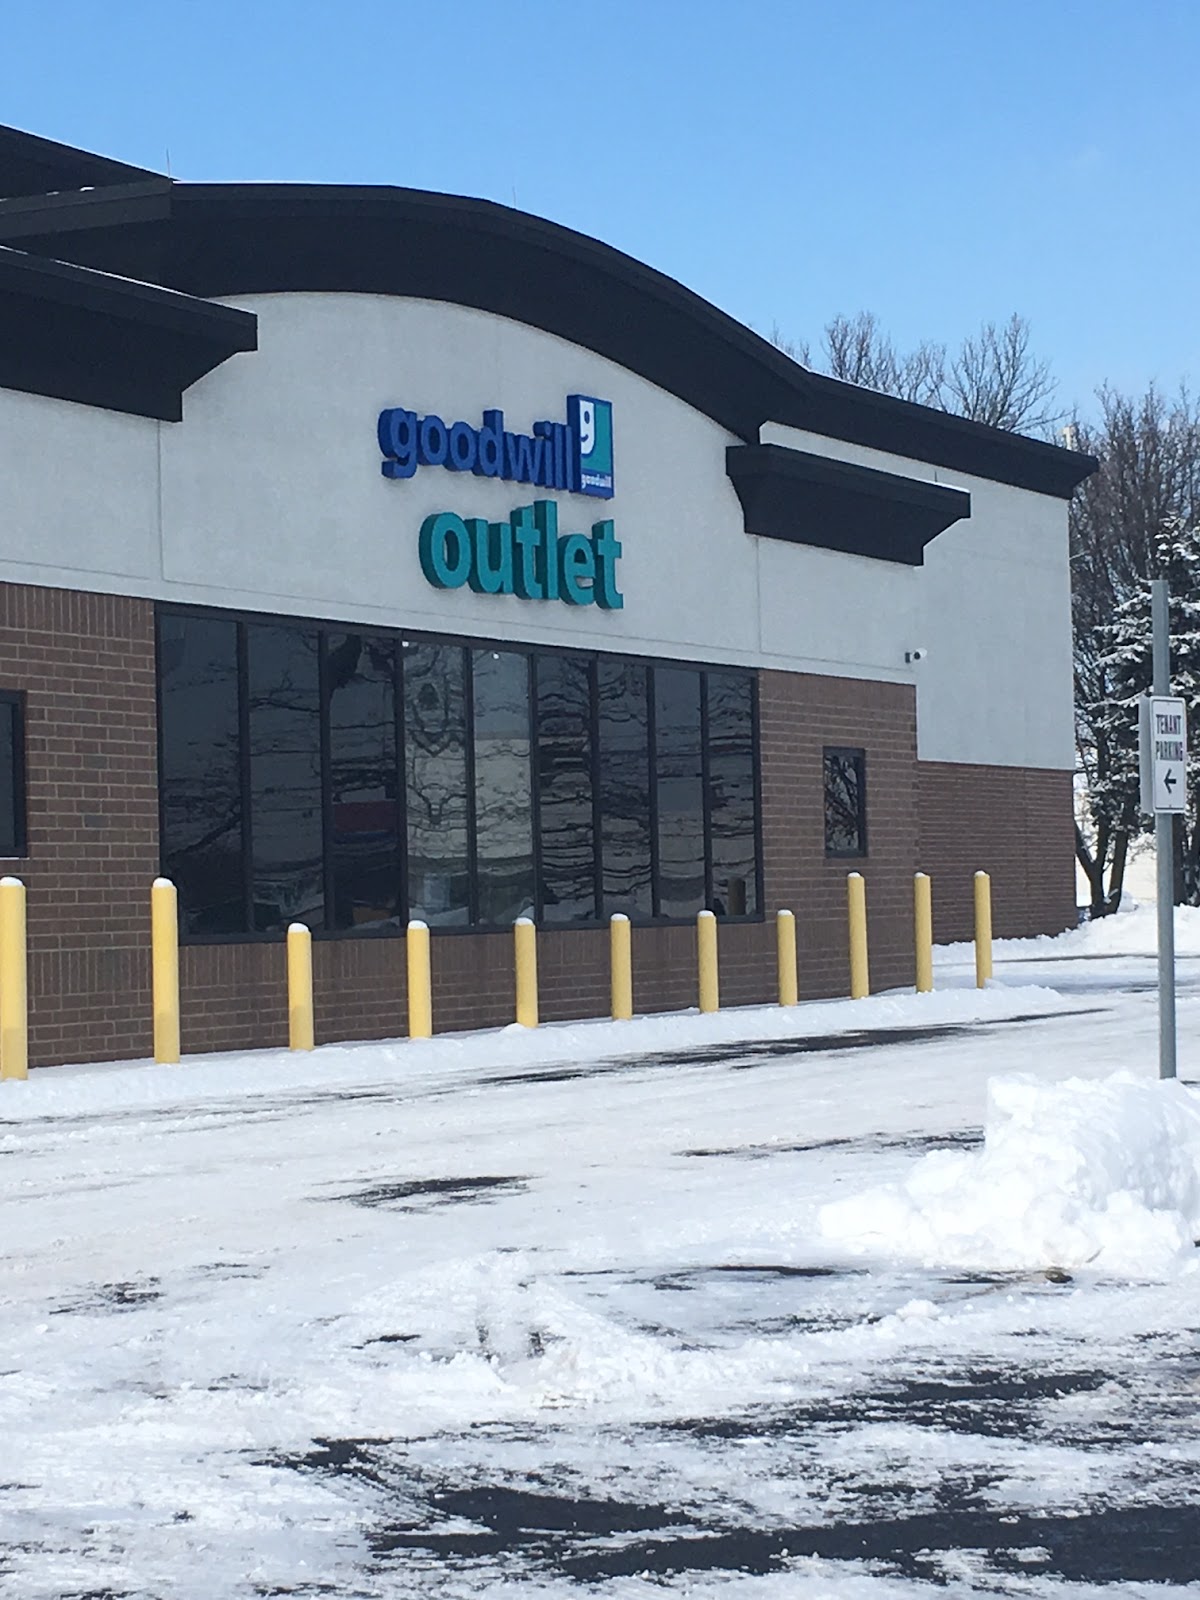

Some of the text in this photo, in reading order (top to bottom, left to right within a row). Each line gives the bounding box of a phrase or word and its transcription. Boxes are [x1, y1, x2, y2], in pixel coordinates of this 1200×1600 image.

[378, 407, 574, 492] goodwill
[419, 500, 624, 609] outlet
[1155, 713, 1182, 735] TENANT
[1155, 740, 1183, 761] PARKING
